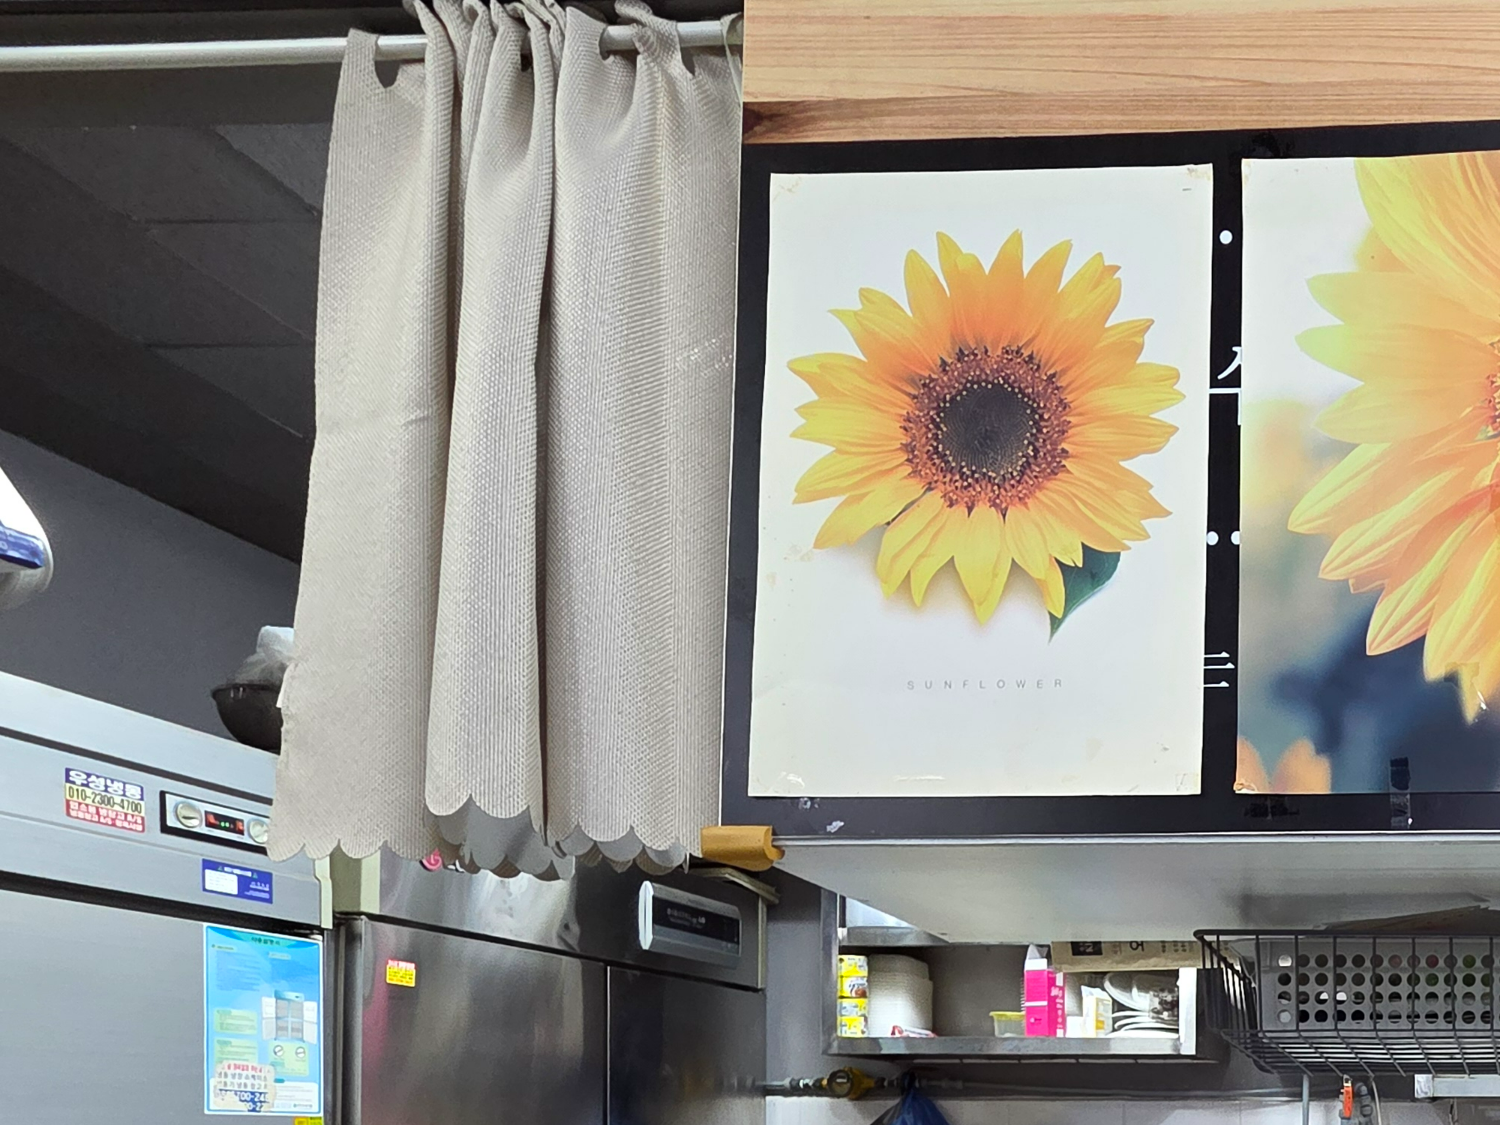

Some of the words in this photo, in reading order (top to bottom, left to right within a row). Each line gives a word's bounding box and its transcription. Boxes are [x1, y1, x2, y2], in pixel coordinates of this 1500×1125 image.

[906, 678, 1062, 691] SUNFLOWER
[68, 769, 142, 800] 우성냉동
[68, 785, 143, 815] 010-2300-4700
